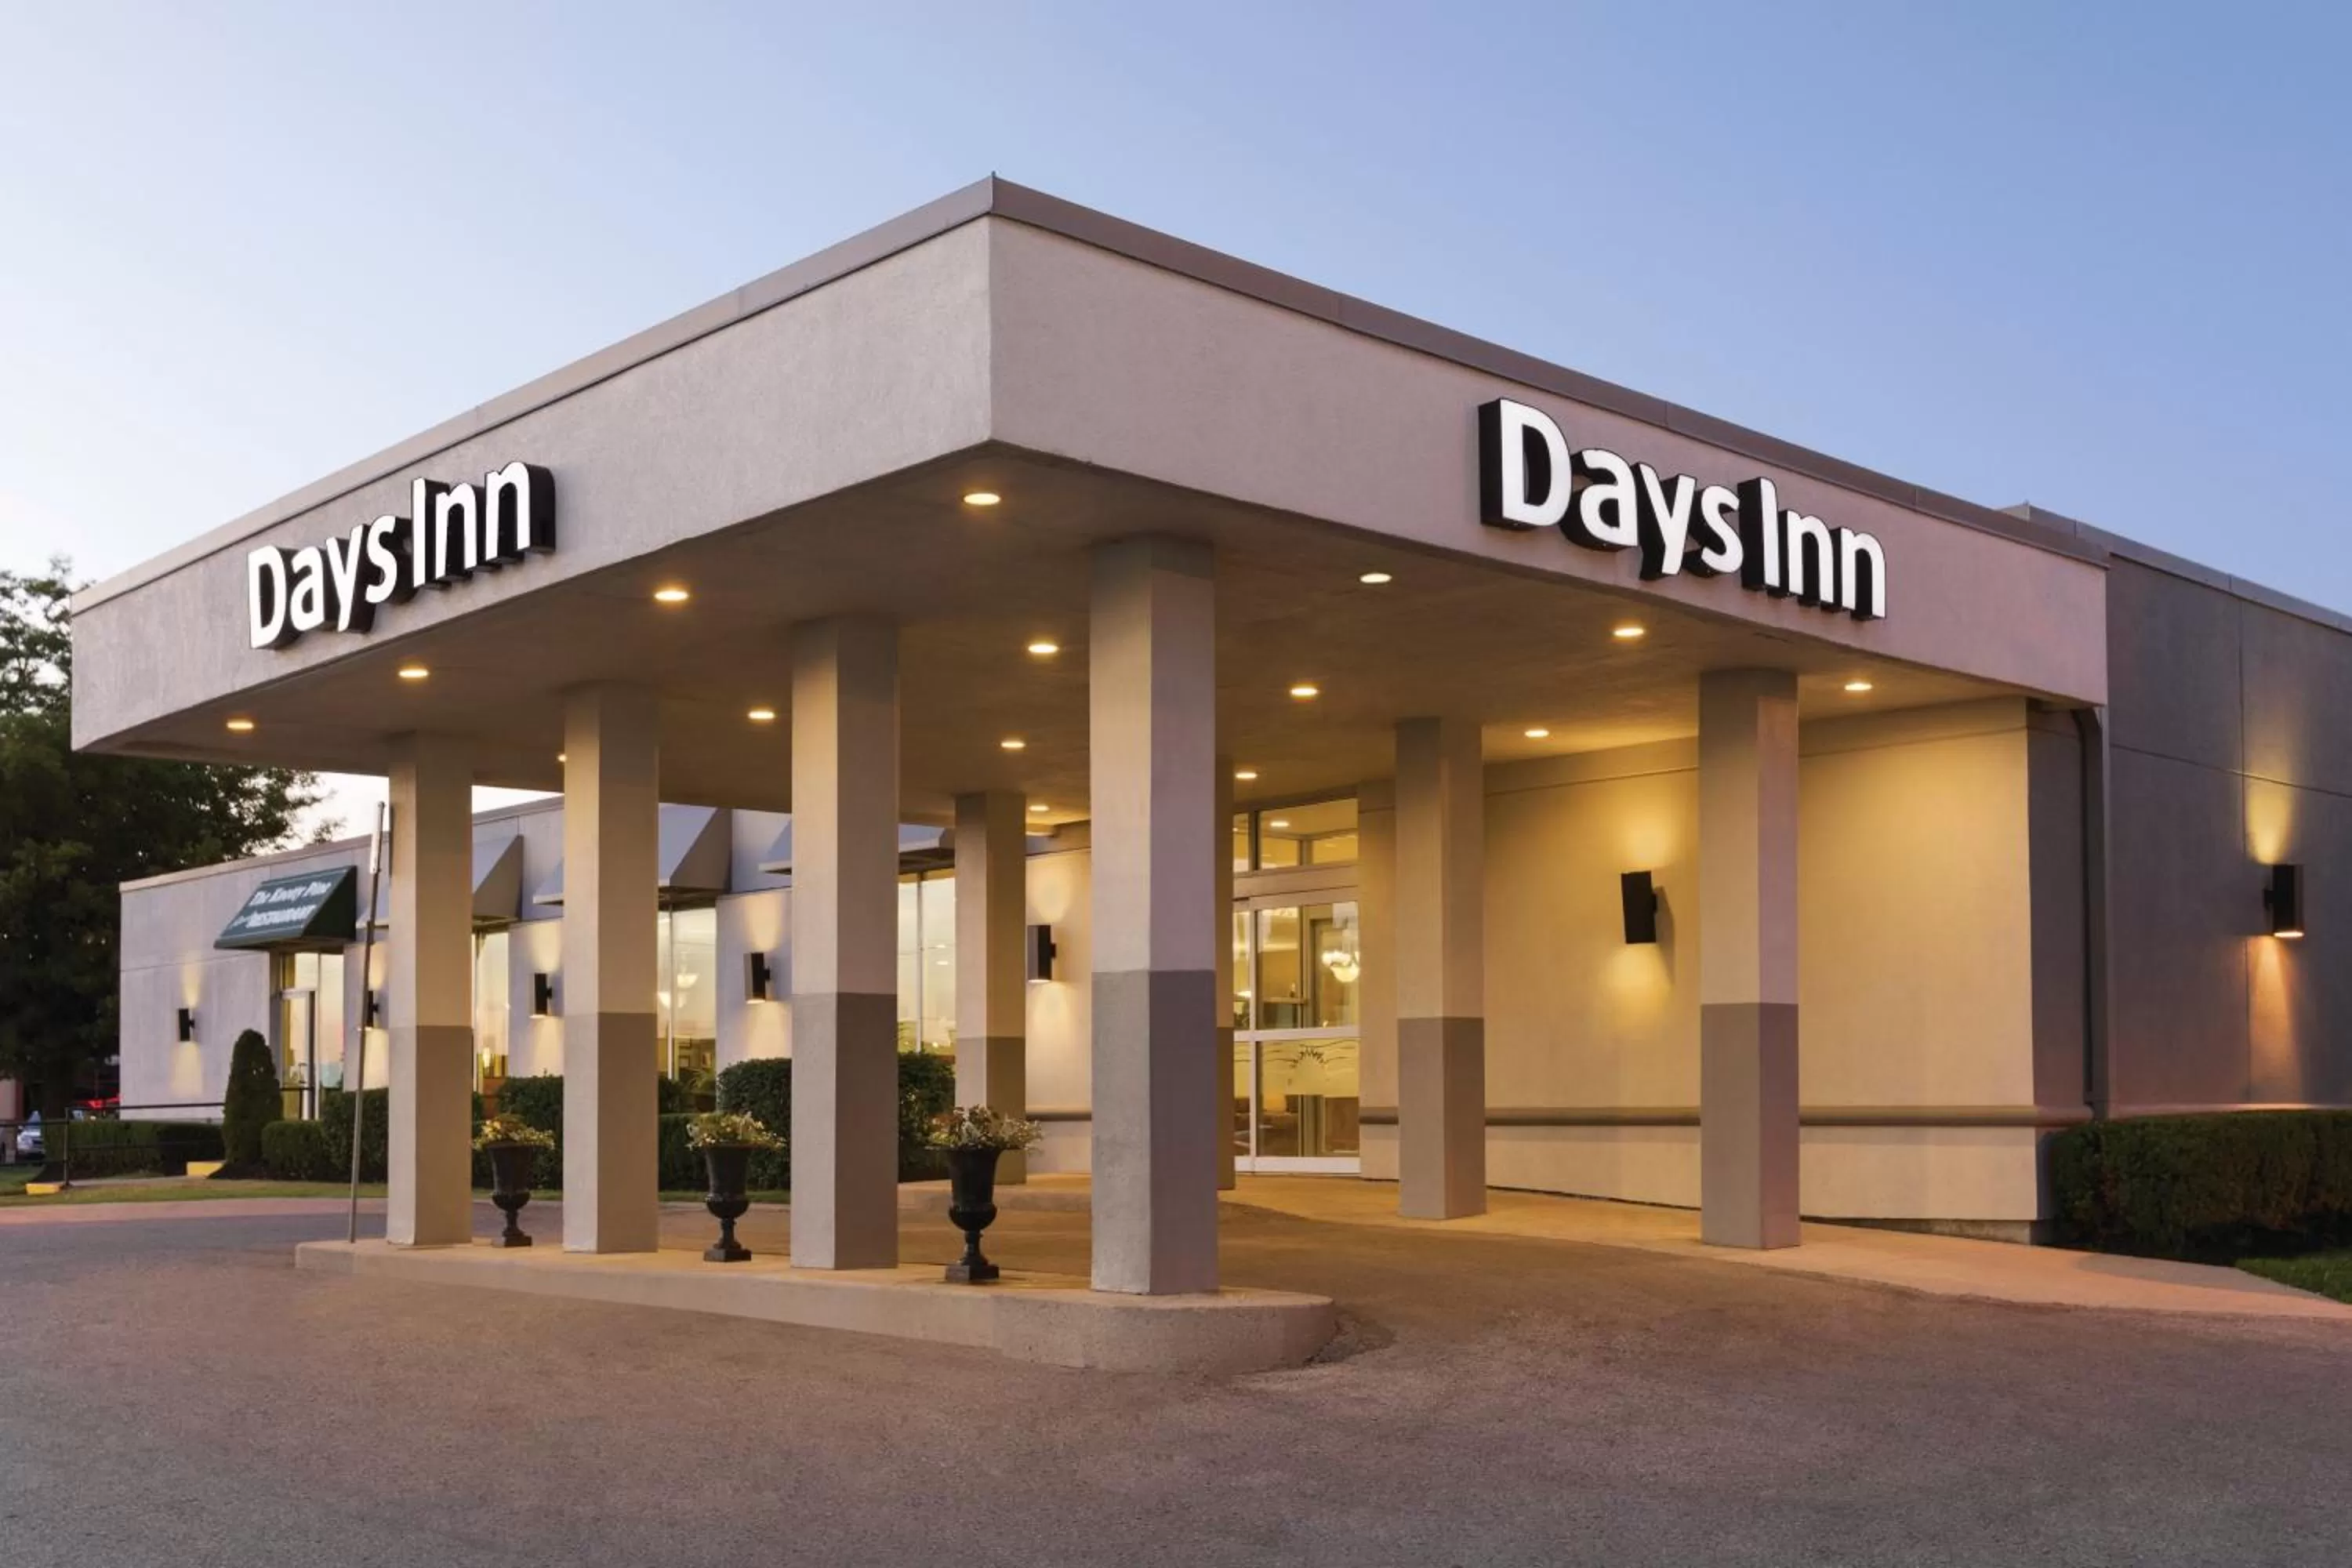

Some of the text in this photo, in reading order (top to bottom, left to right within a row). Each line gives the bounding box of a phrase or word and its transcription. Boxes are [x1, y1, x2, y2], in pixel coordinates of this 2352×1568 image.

[247, 461, 532, 649] Days Inn
[1500, 398, 1886, 619] Days Inn
